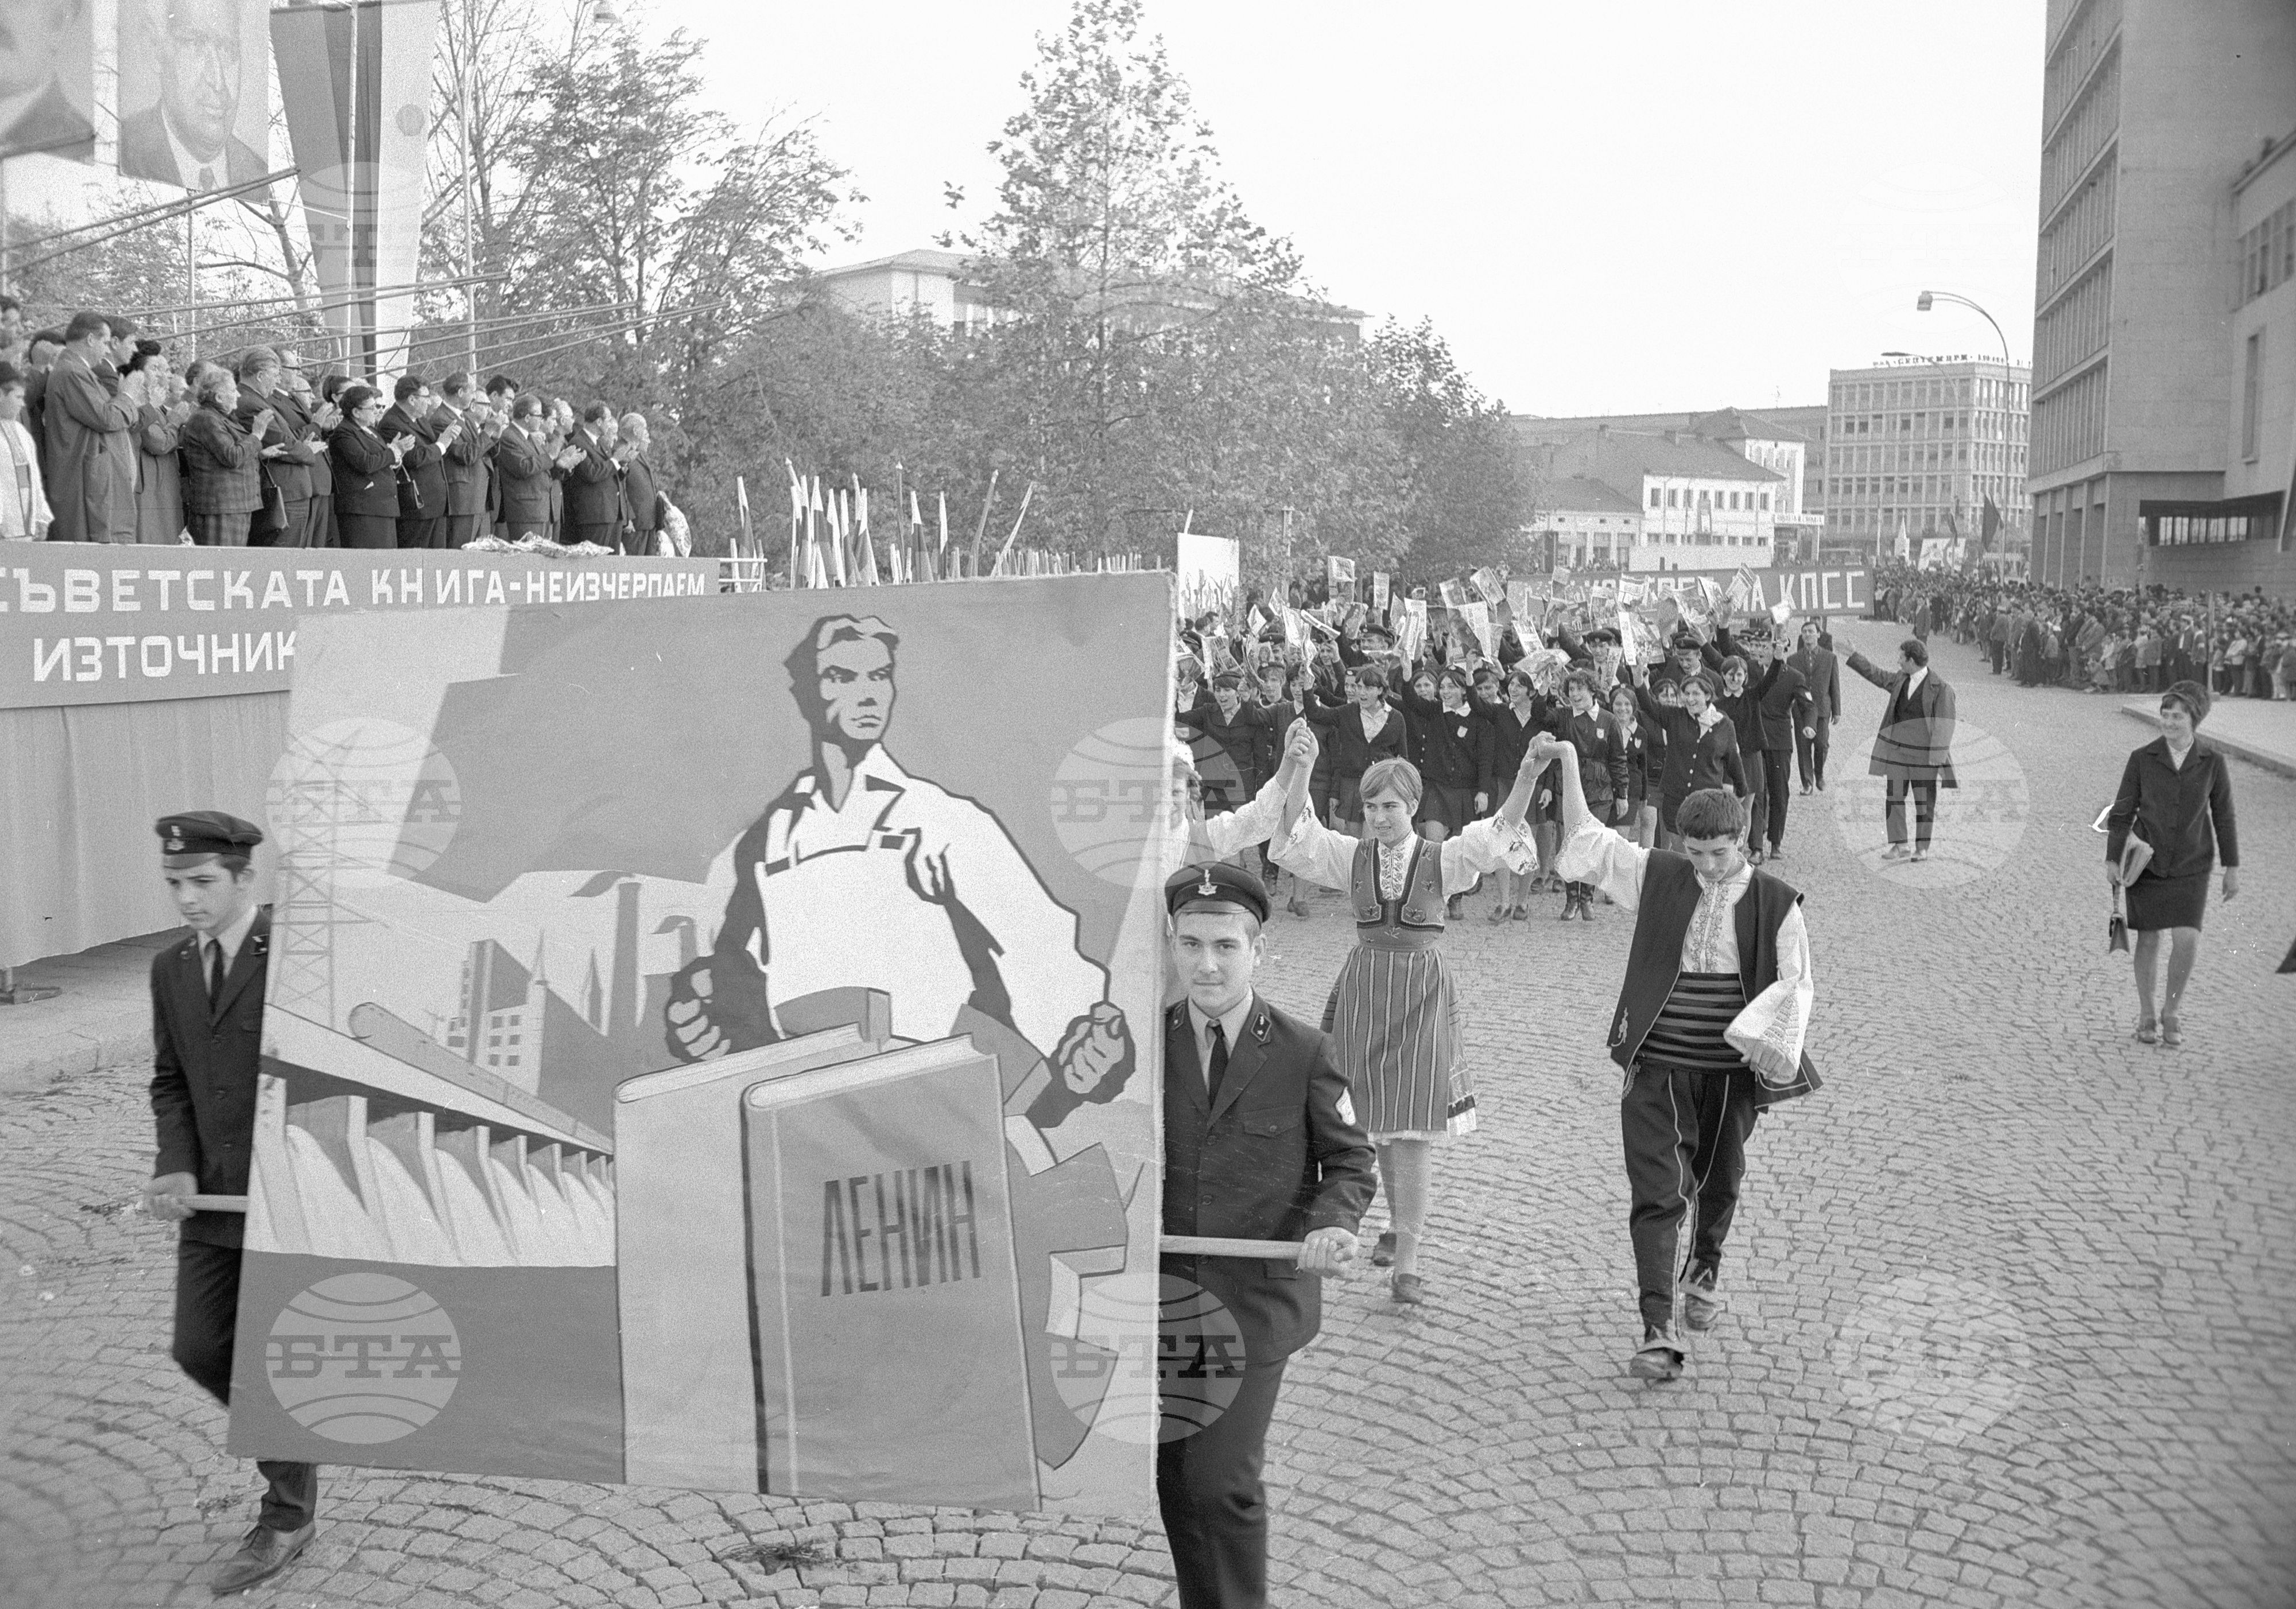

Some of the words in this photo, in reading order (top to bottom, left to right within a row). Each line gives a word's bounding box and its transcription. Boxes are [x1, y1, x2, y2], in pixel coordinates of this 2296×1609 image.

[0, 568, 350, 612] ЪВЕТСКАТА
[1779, 571, 1865, 610] КПСС
[33, 631, 296, 682] ИЗТОЧНИК
[821, 1160, 981, 1297] ЛЕНИН
